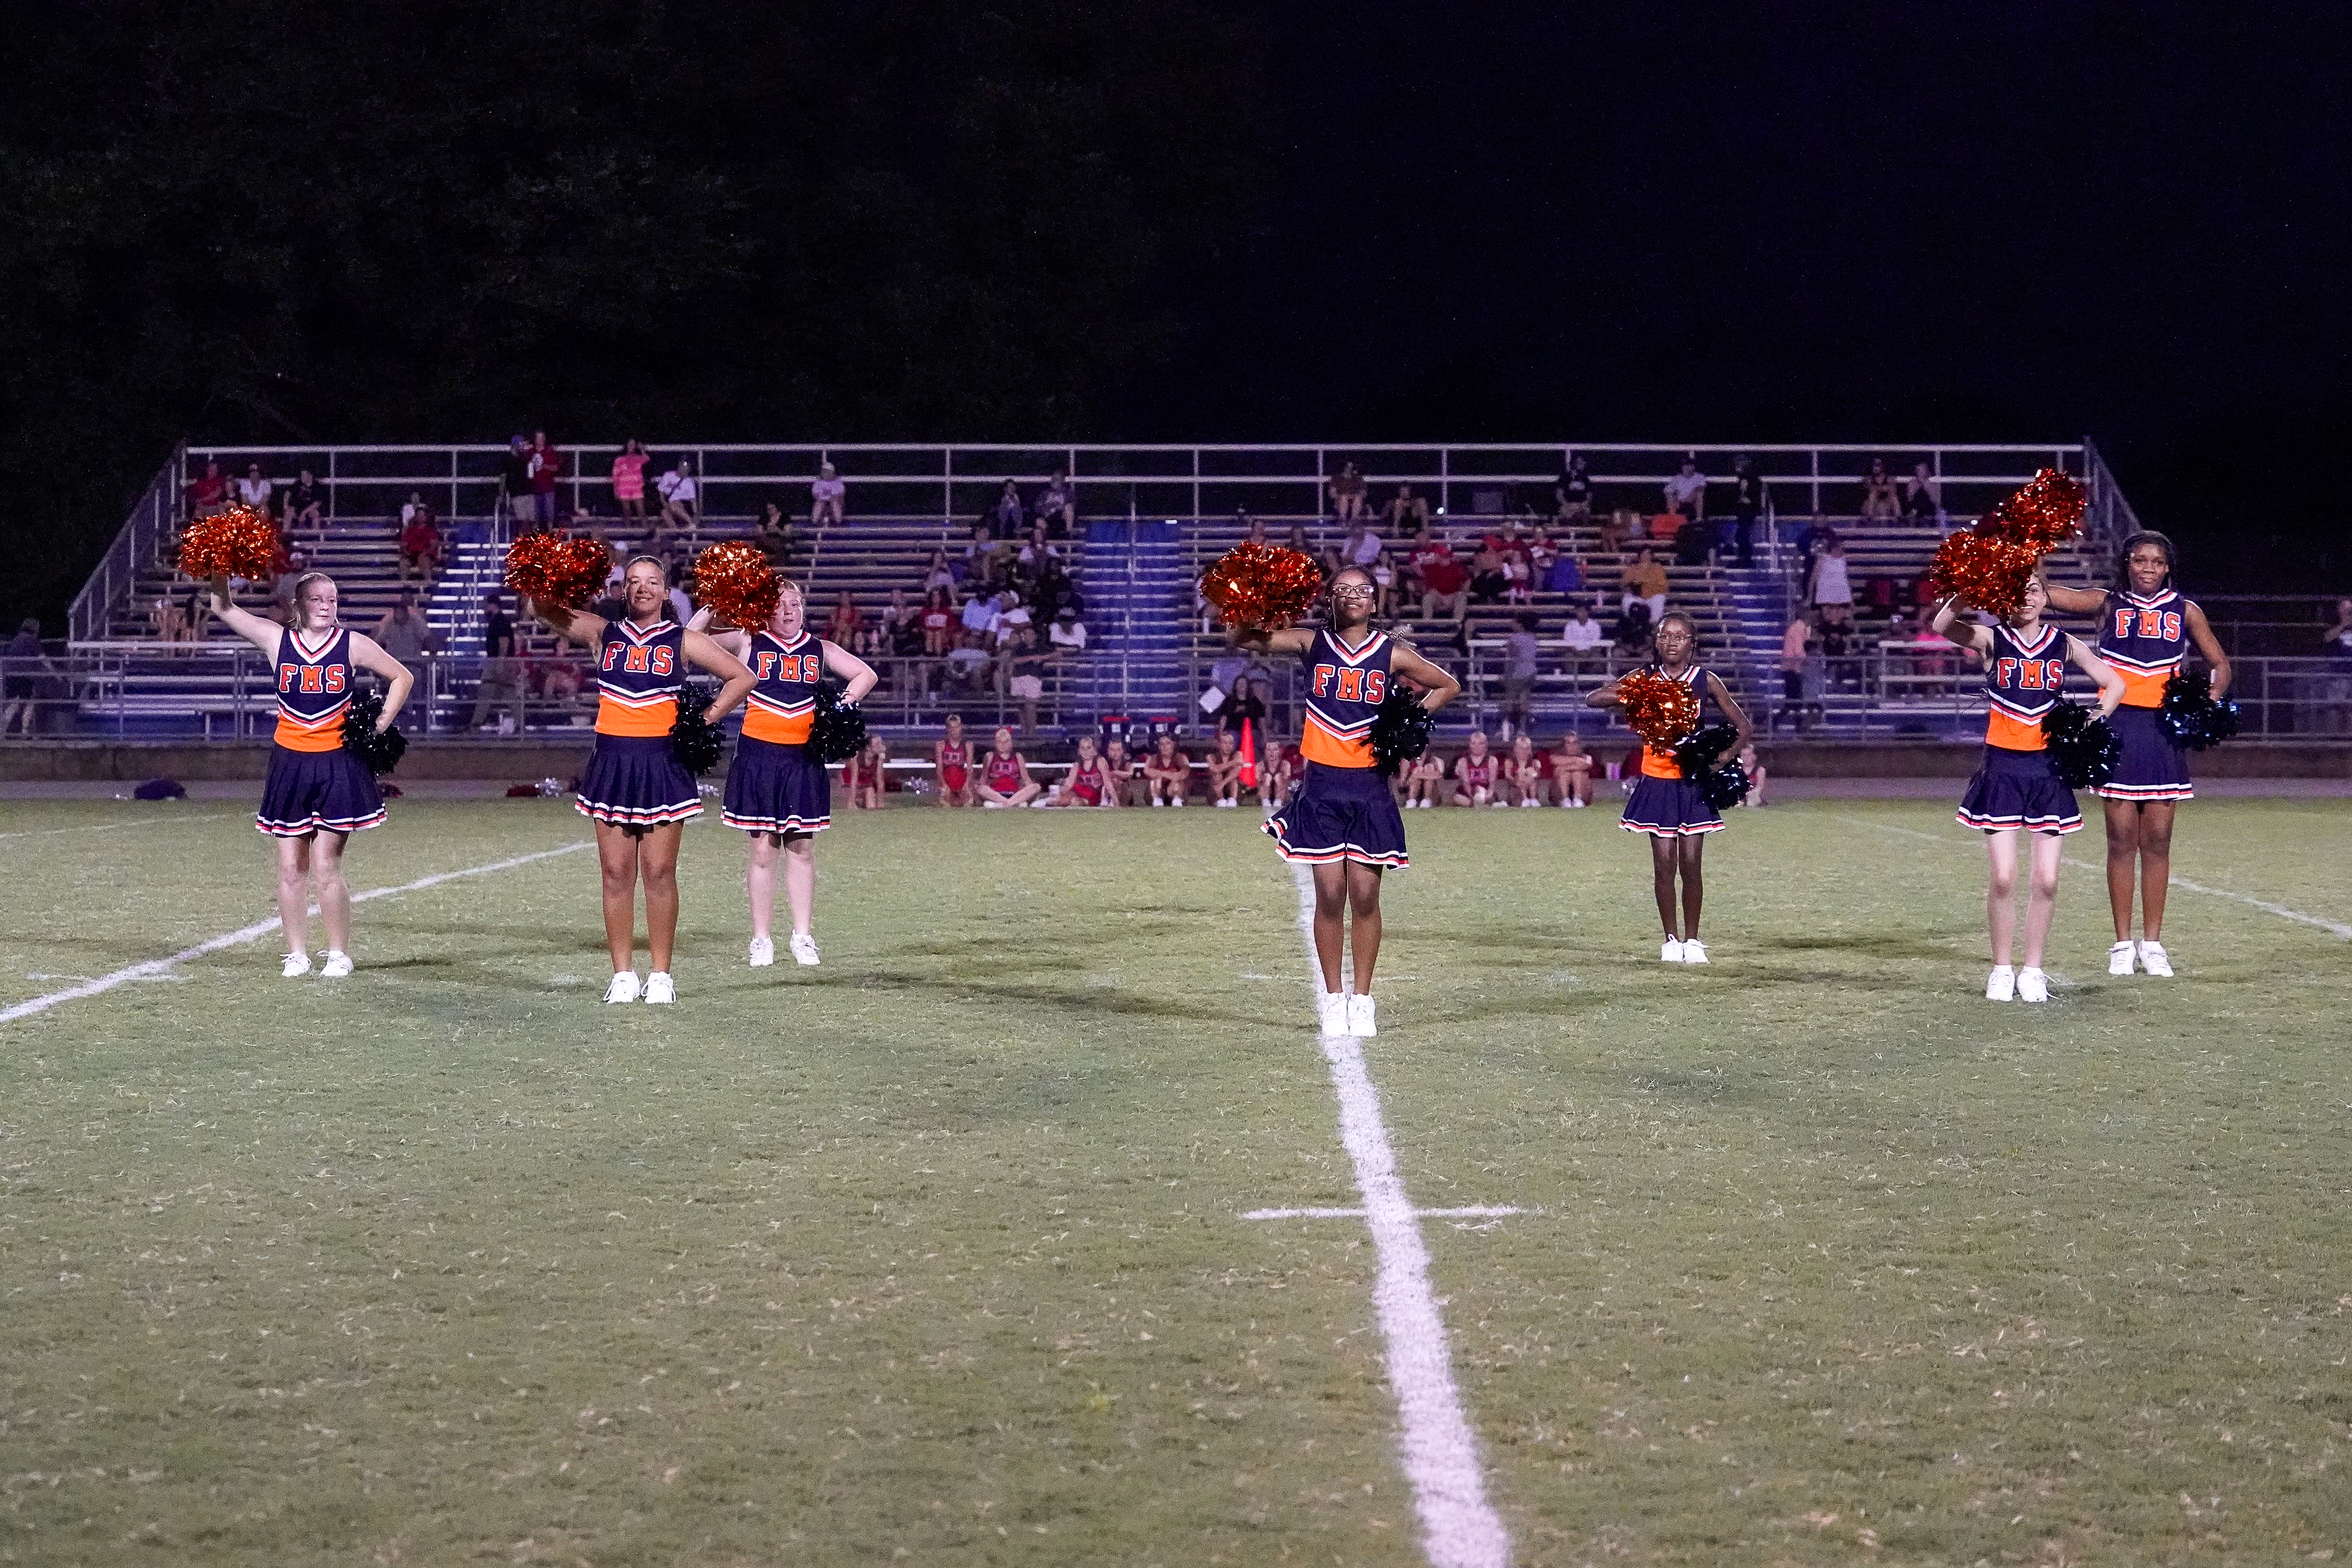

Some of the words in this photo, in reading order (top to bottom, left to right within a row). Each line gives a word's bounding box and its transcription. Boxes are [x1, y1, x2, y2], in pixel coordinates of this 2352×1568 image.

[2116, 608, 2180, 642] FMS
[602, 641, 673, 676] FMS
[757, 652, 819, 684] FMS
[1997, 657, 2064, 691] FMS
[279, 663, 345, 693] FMS
[1313, 663, 1385, 704] FMS
